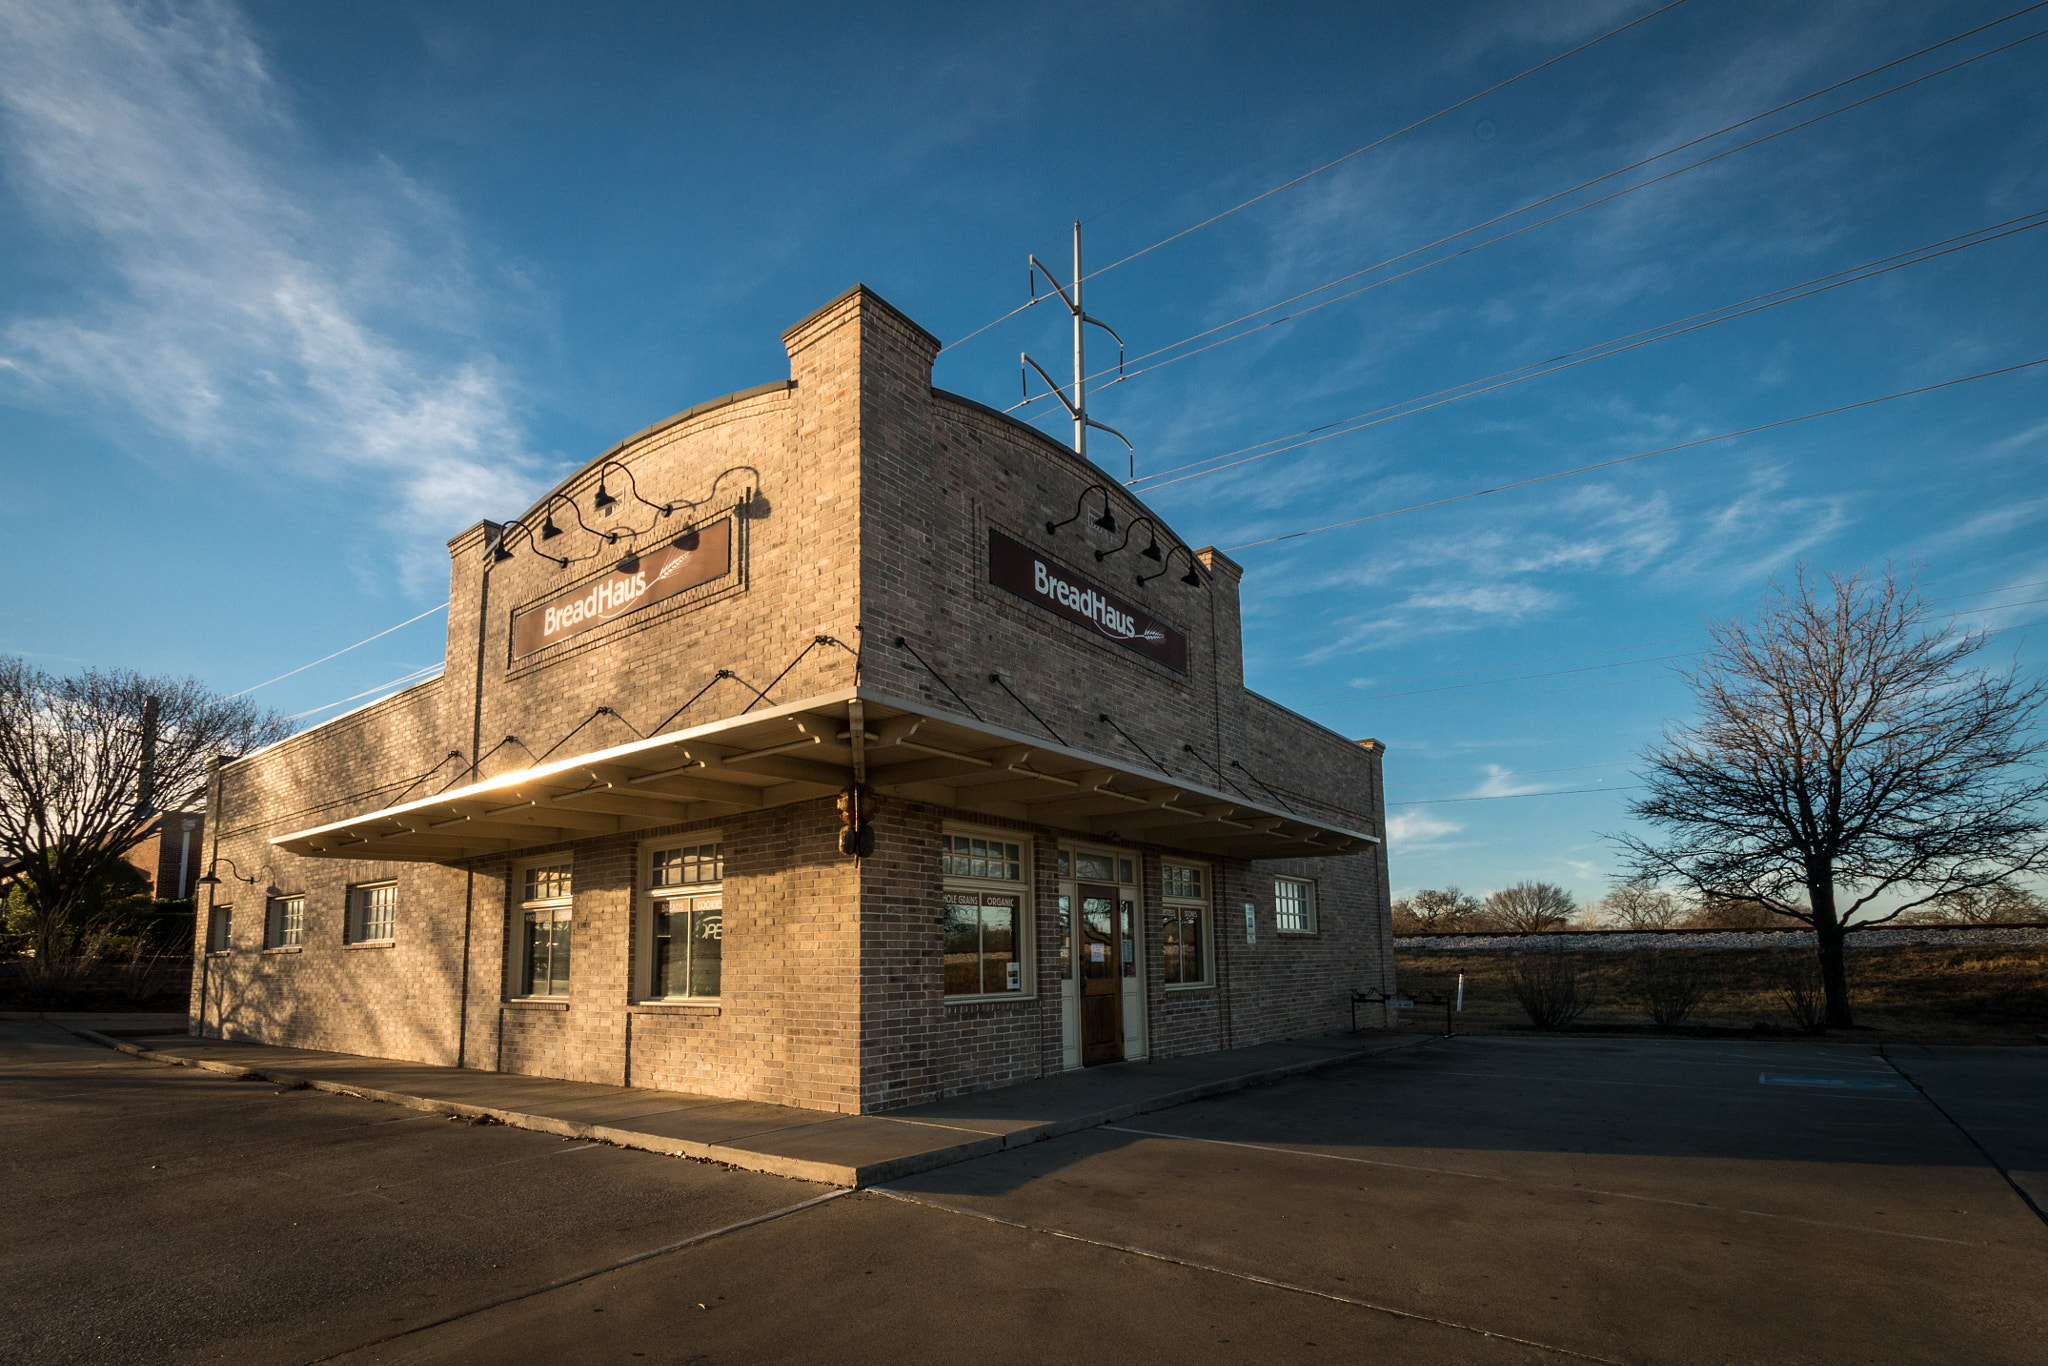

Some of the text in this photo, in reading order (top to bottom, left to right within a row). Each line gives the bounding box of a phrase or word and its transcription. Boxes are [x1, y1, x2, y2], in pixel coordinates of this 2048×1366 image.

[544, 571, 647, 636] BreadHaus
[1034, 560, 1136, 638] BreadHaus
[943, 894, 979, 905] HOLE GRAINS
[986, 896, 1015, 907] ORGANIC
[661, 902, 684, 913] BREADS
[695, 923, 723, 940] OPE
